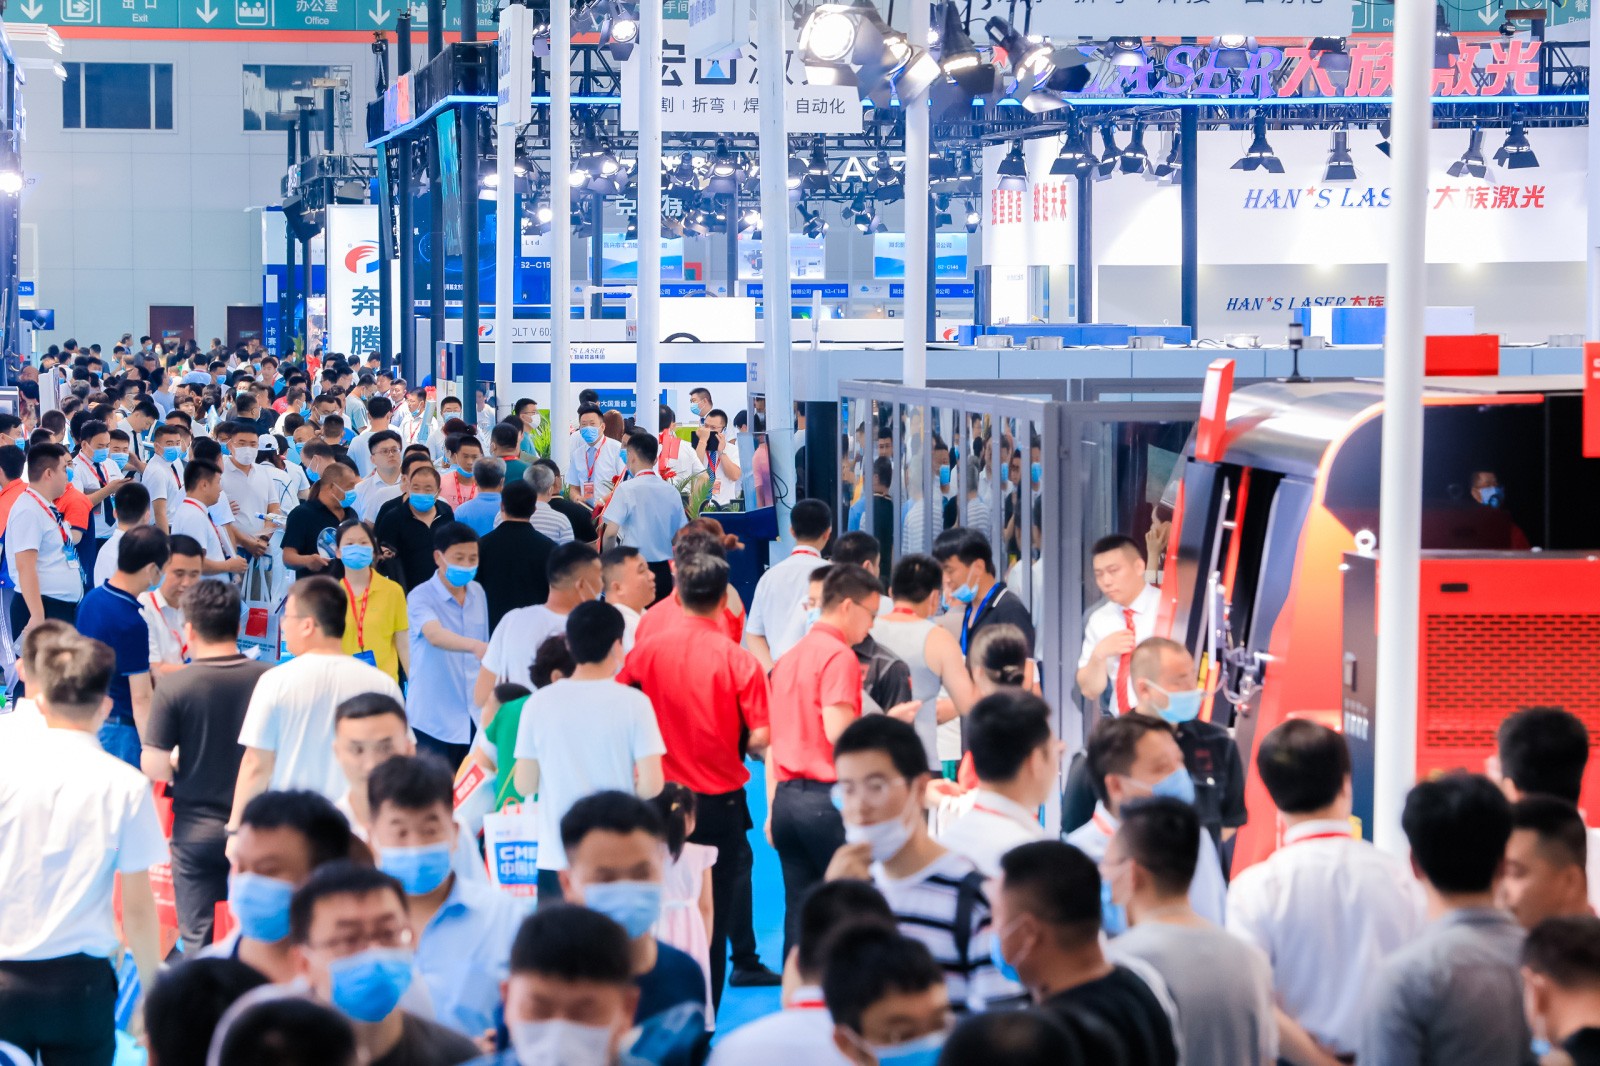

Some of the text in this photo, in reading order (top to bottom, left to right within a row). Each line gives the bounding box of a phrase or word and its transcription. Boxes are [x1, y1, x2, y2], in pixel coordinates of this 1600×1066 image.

[296, 0, 338, 13] 办公室
[132, 14, 149, 23] Exit
[304, 16, 330, 25] Office
[692, 97, 726, 114] 折弯
[796, 98, 846, 115] 自动化
[1434, 185, 1546, 210] 大族激光
[350, 286, 380, 356] 奔腾
